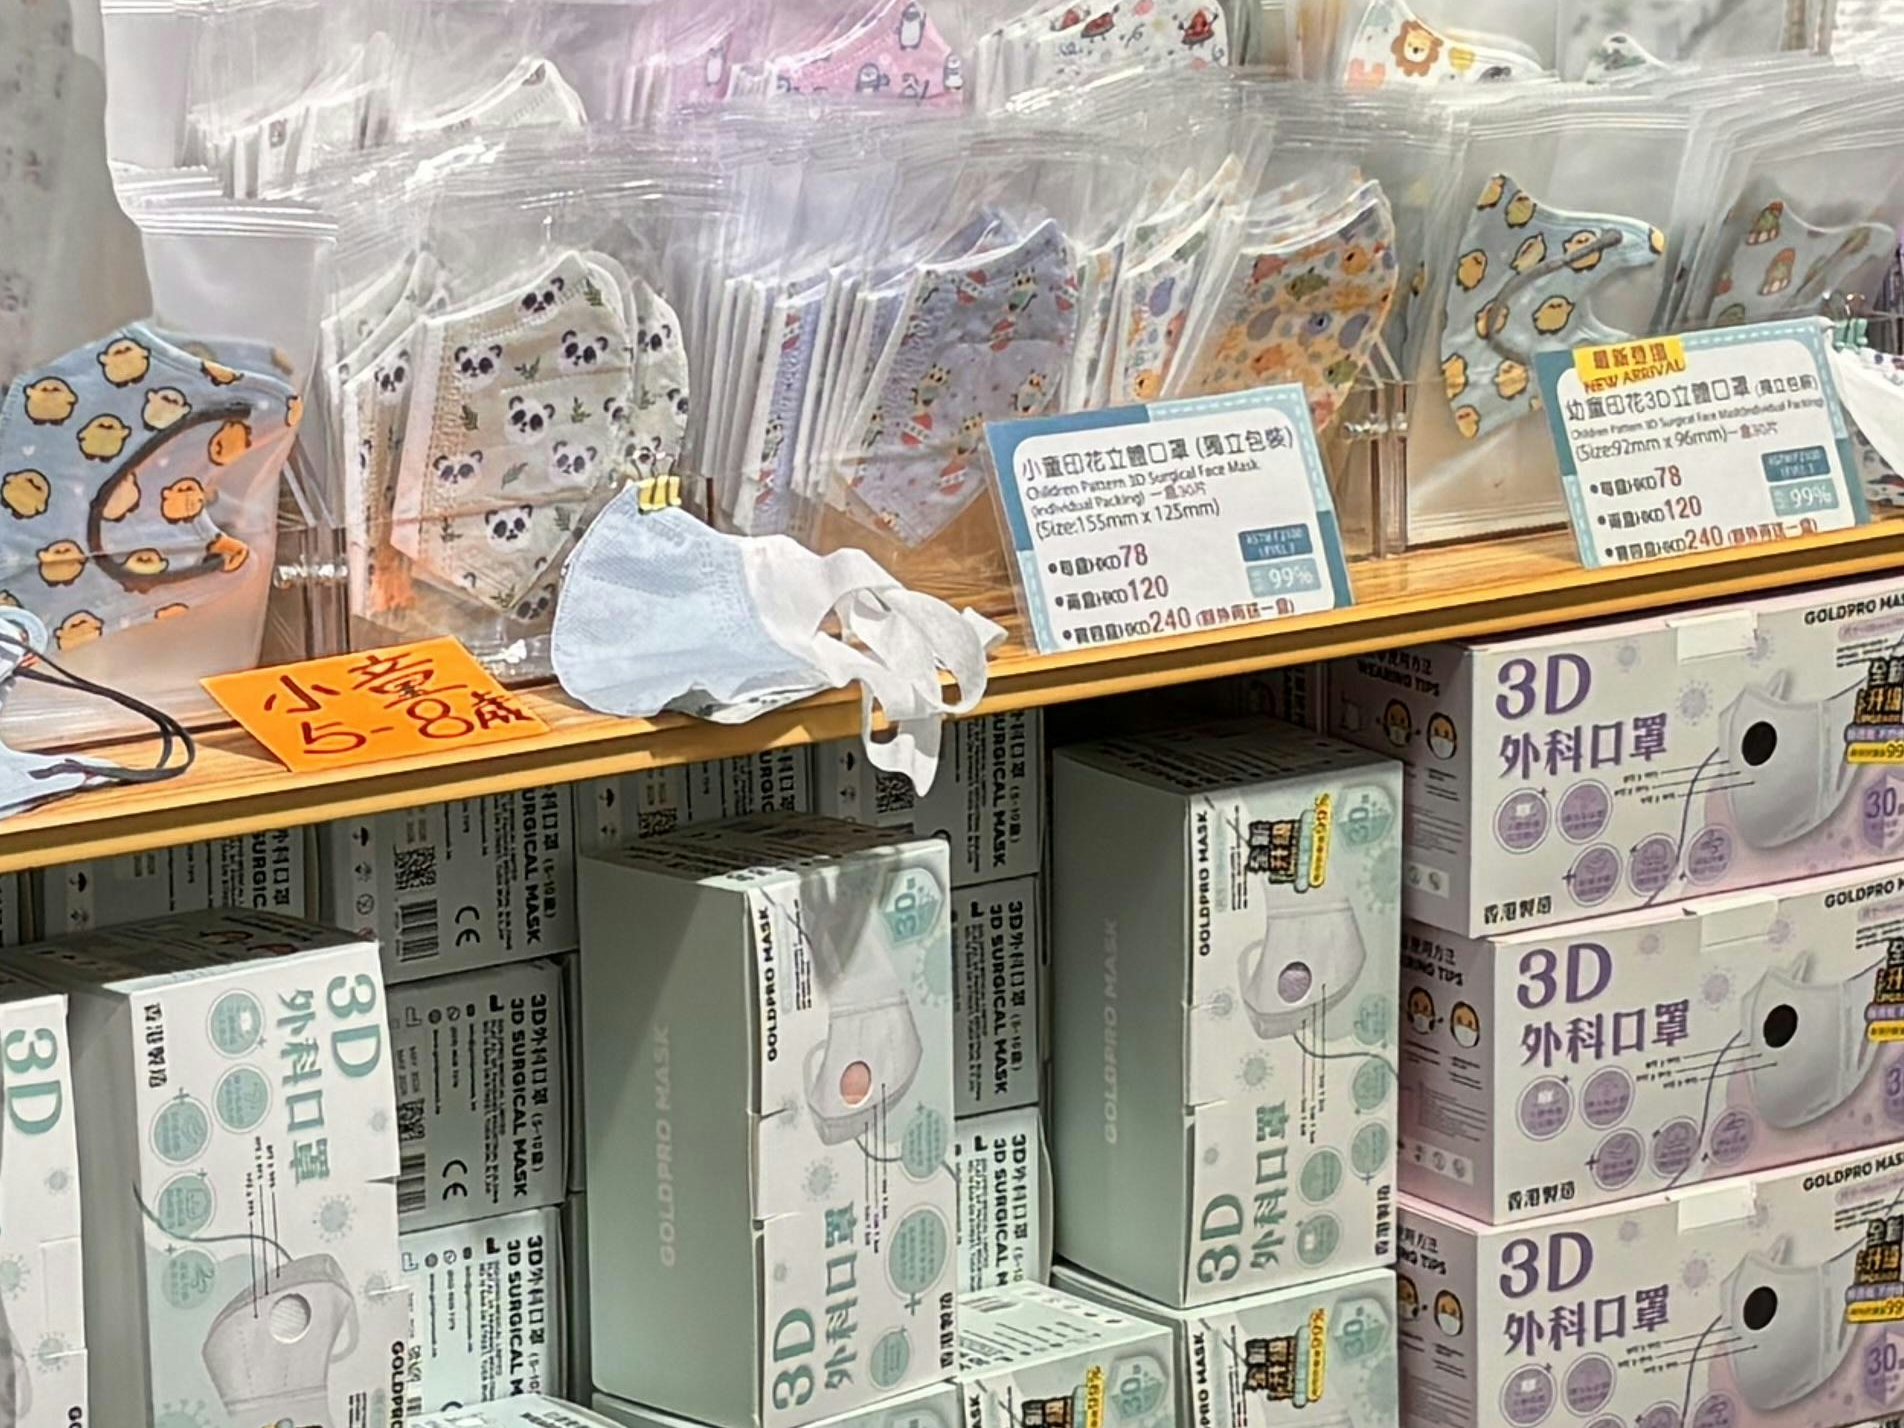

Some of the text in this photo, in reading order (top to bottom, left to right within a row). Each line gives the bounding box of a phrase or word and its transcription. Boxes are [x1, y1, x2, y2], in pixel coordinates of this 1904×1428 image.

[1566, 375, 1751, 422] 幼童印花3D立體口罩
[1584, 359, 1686, 395] NEW ARRIVAL
[1022, 426, 1294, 482] 小童印花立體口罩 (獨立包裝)
[1155, 499, 1220, 522] 125mm)
[1268, 565, 1314, 589] 99%
[1803, 597, 1877, 627] GOLDPRO
[263, 651, 467, 713] 小童
[1495, 652, 1593, 722] 3D
[301, 689, 533, 756] 5-8歲
[1498, 712, 1669, 781] 外科口罩
[1194, 809, 1213, 957] GOLDPRO MASK
[1483, 894, 1553, 925] 香港製造
[1, 1027, 63, 1136] 3D
[276, 987, 333, 1186] 外科口罩
[509, 1029, 527, 1130] SURGICAL
[510, 1133, 529, 1197] MASK
[770, 1306, 818, 1410] 3D
